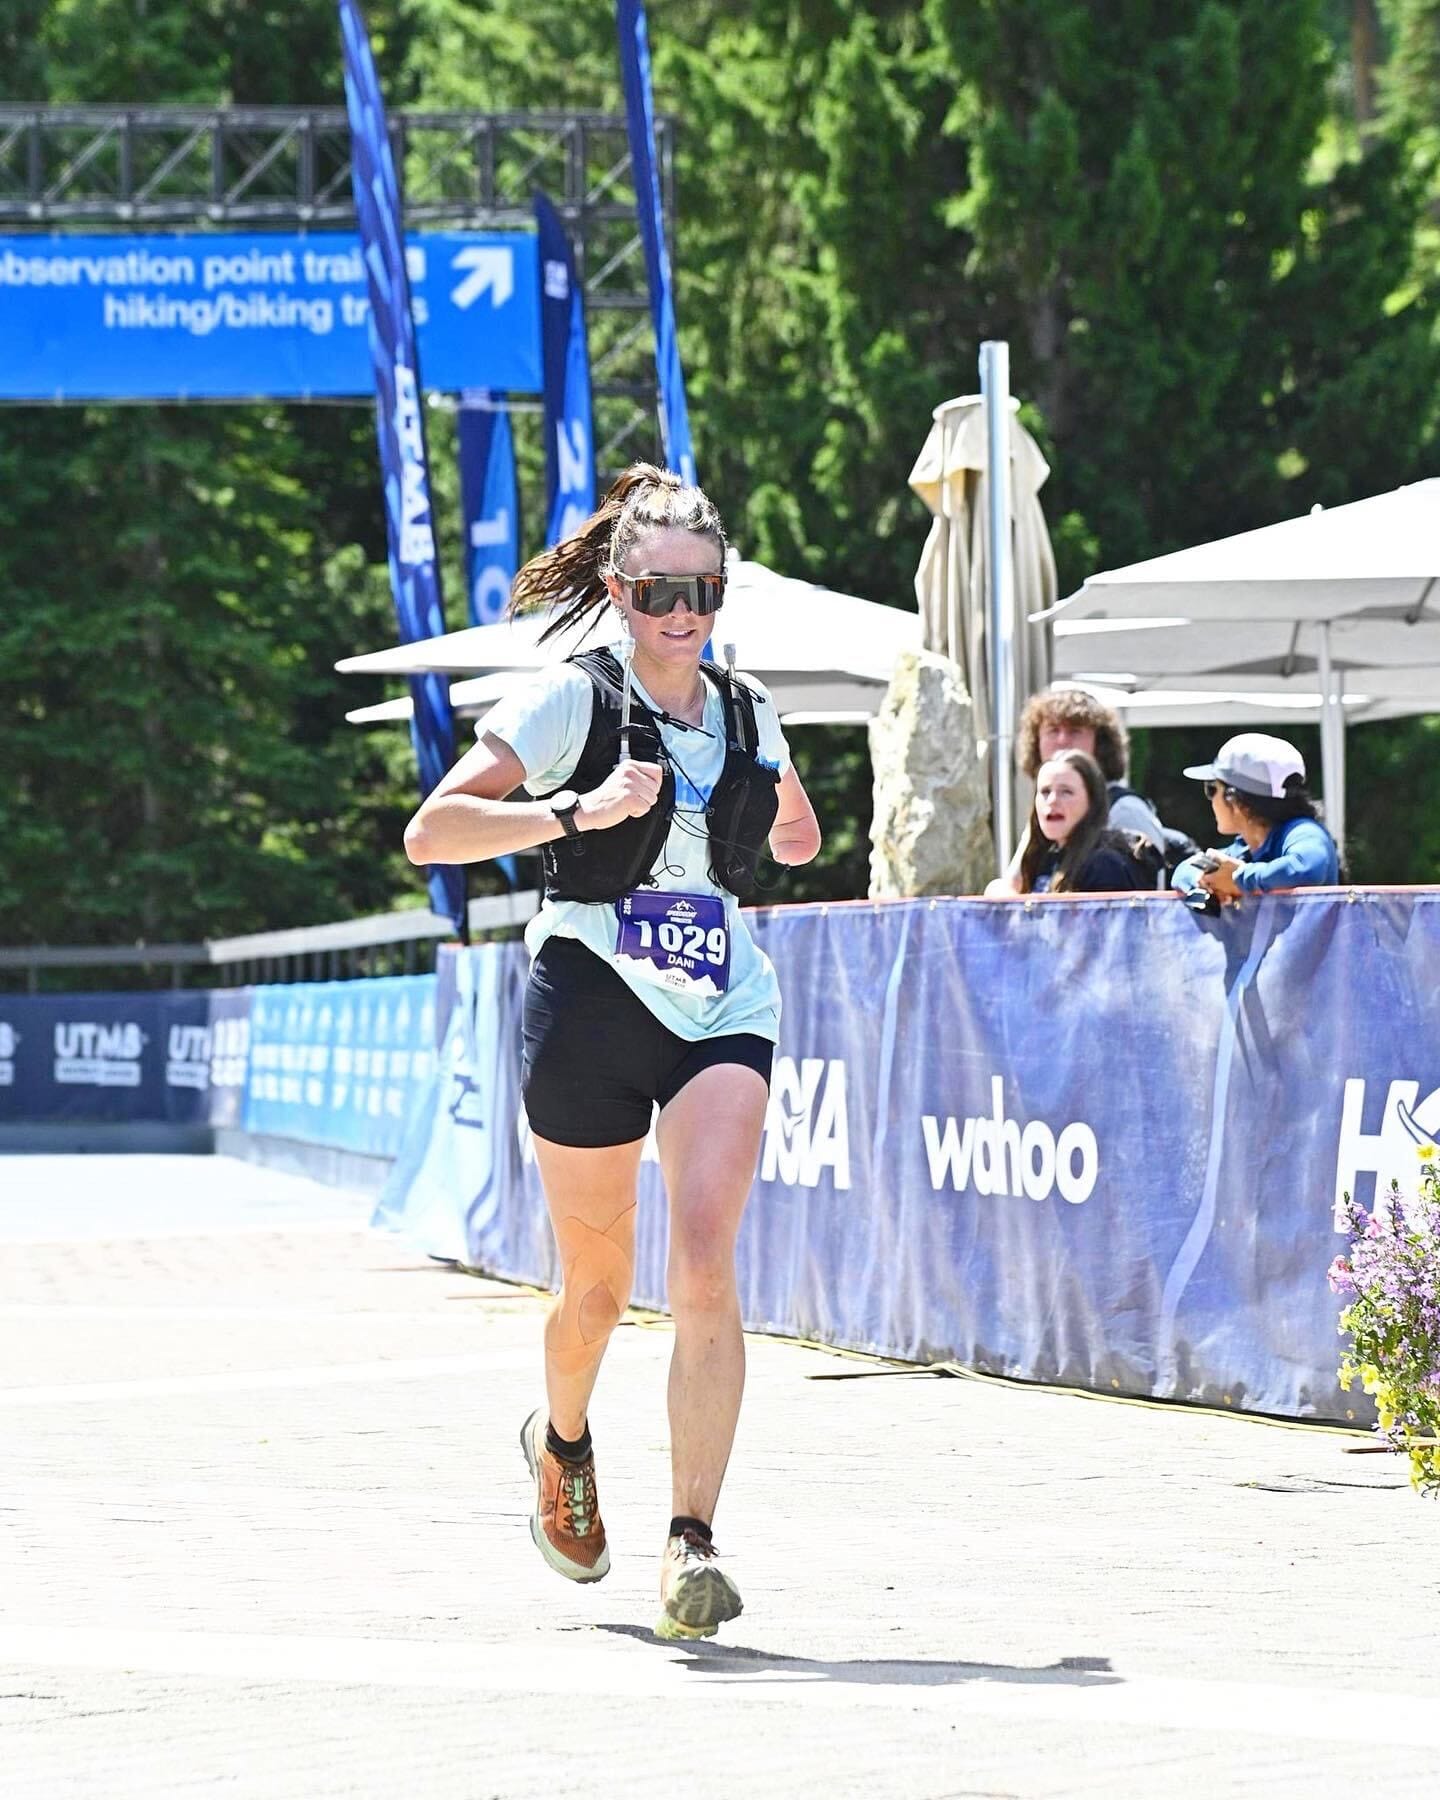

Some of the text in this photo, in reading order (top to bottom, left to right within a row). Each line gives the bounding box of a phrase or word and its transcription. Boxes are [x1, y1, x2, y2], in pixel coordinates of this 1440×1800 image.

[203, 249, 296, 290] point
[304, 249, 367, 285] trai
[104, 294, 333, 335] hiking/biking
[623, 898, 632, 915] 28K
[633, 920, 726, 966] 1029
[667, 953, 695, 969] DANI
[54, 1022, 142, 1059] UTMB
[921, 1075, 1098, 1204] wahoo
